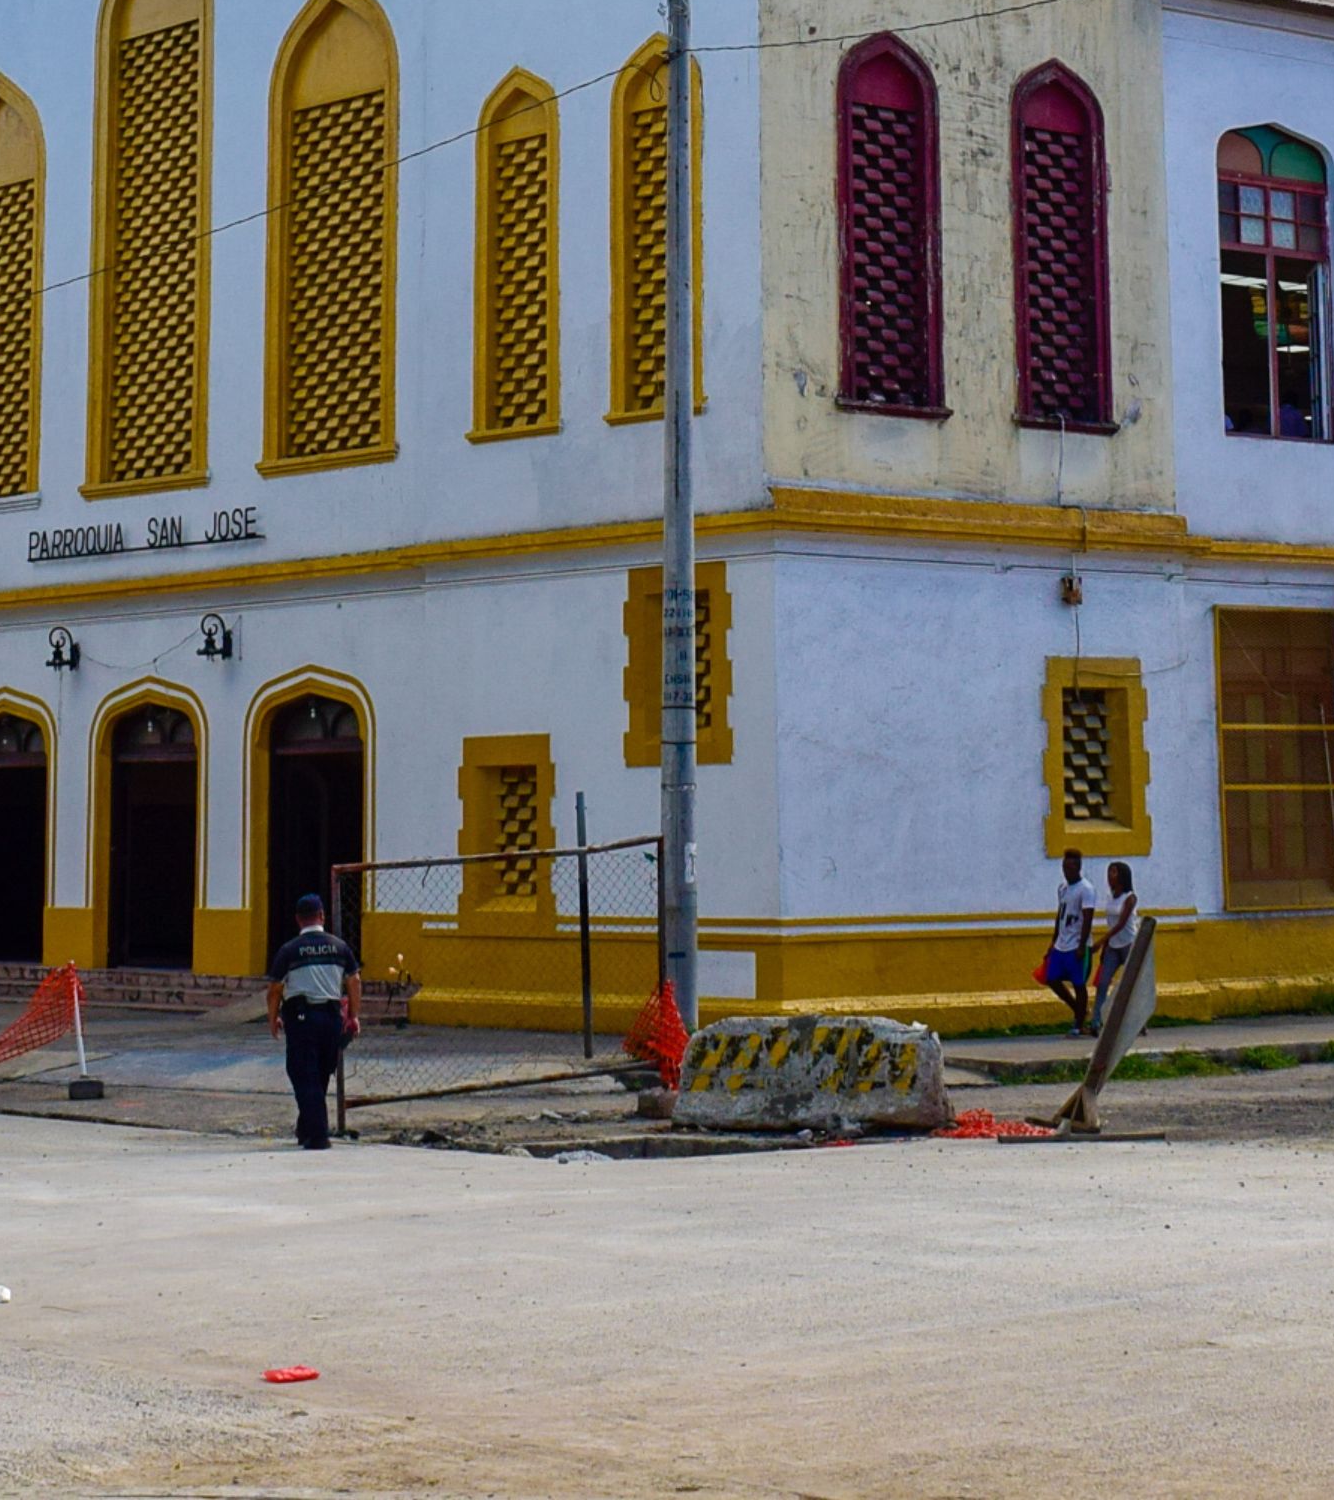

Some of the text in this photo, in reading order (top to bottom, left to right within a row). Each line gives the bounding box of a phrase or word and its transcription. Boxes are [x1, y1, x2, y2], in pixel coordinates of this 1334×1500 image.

[29, 506, 257, 560] PARROQUIA SAN JOSE
[299, 945, 338, 956] POLICIA
